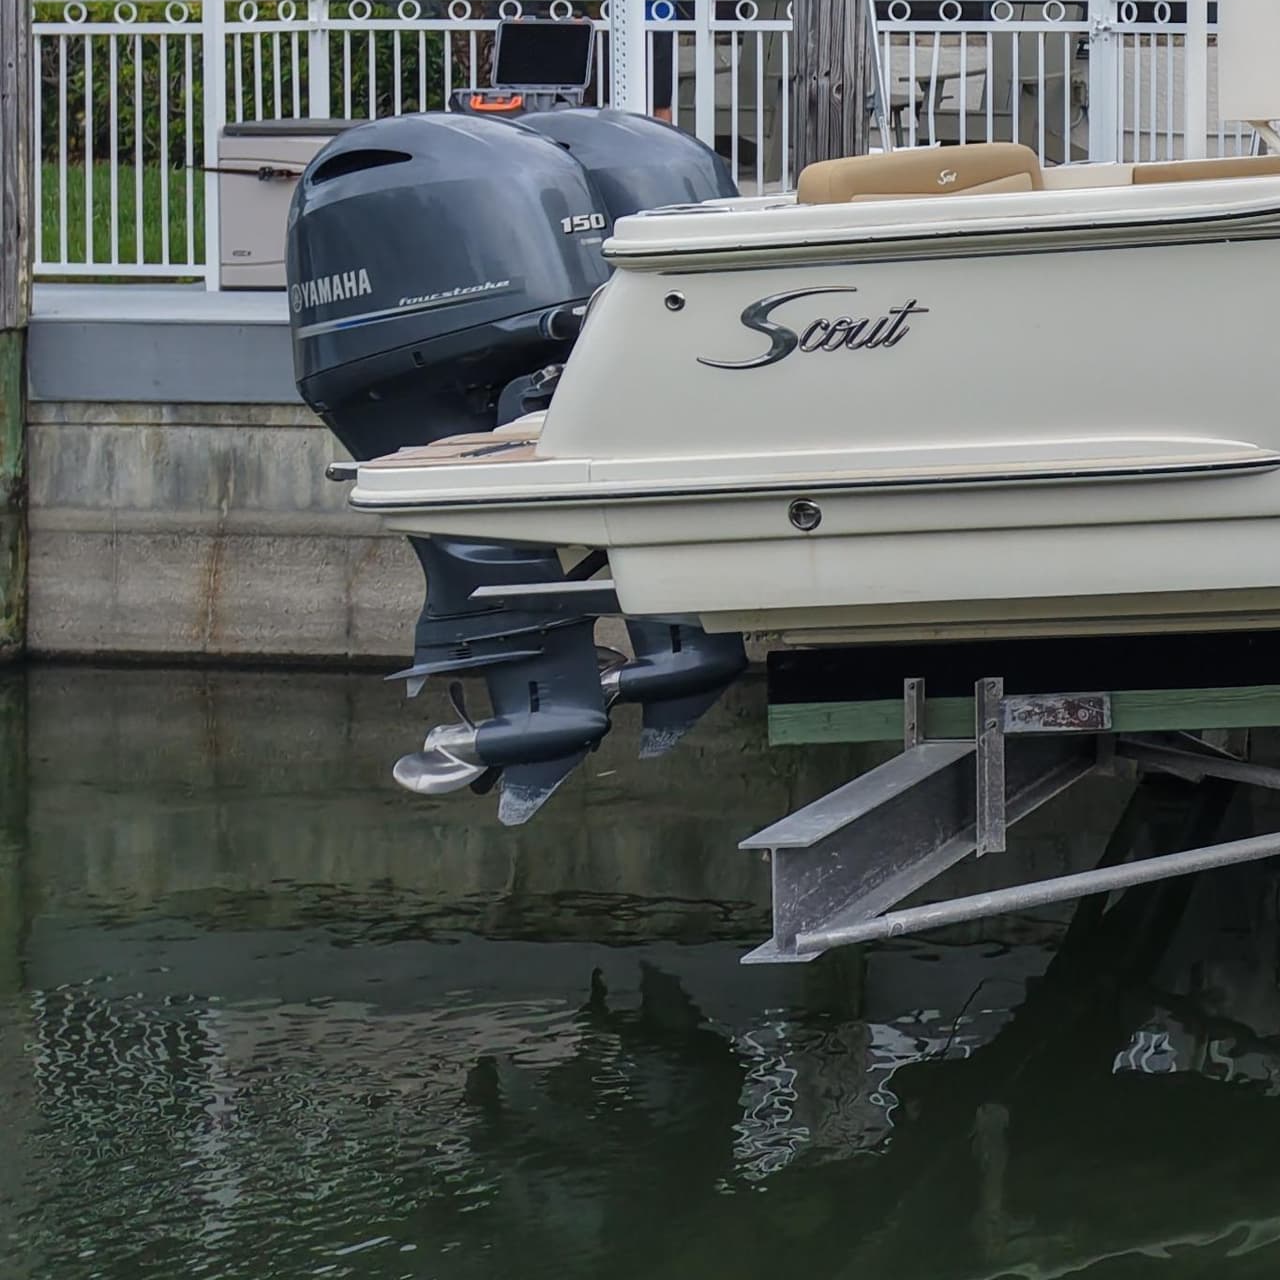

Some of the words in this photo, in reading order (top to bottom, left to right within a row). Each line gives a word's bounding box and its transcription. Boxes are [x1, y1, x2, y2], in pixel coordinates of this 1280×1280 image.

[560, 213, 606, 233] 150
[301, 268, 373, 309] YAMAHA
[696, 286, 930, 370] Scout
